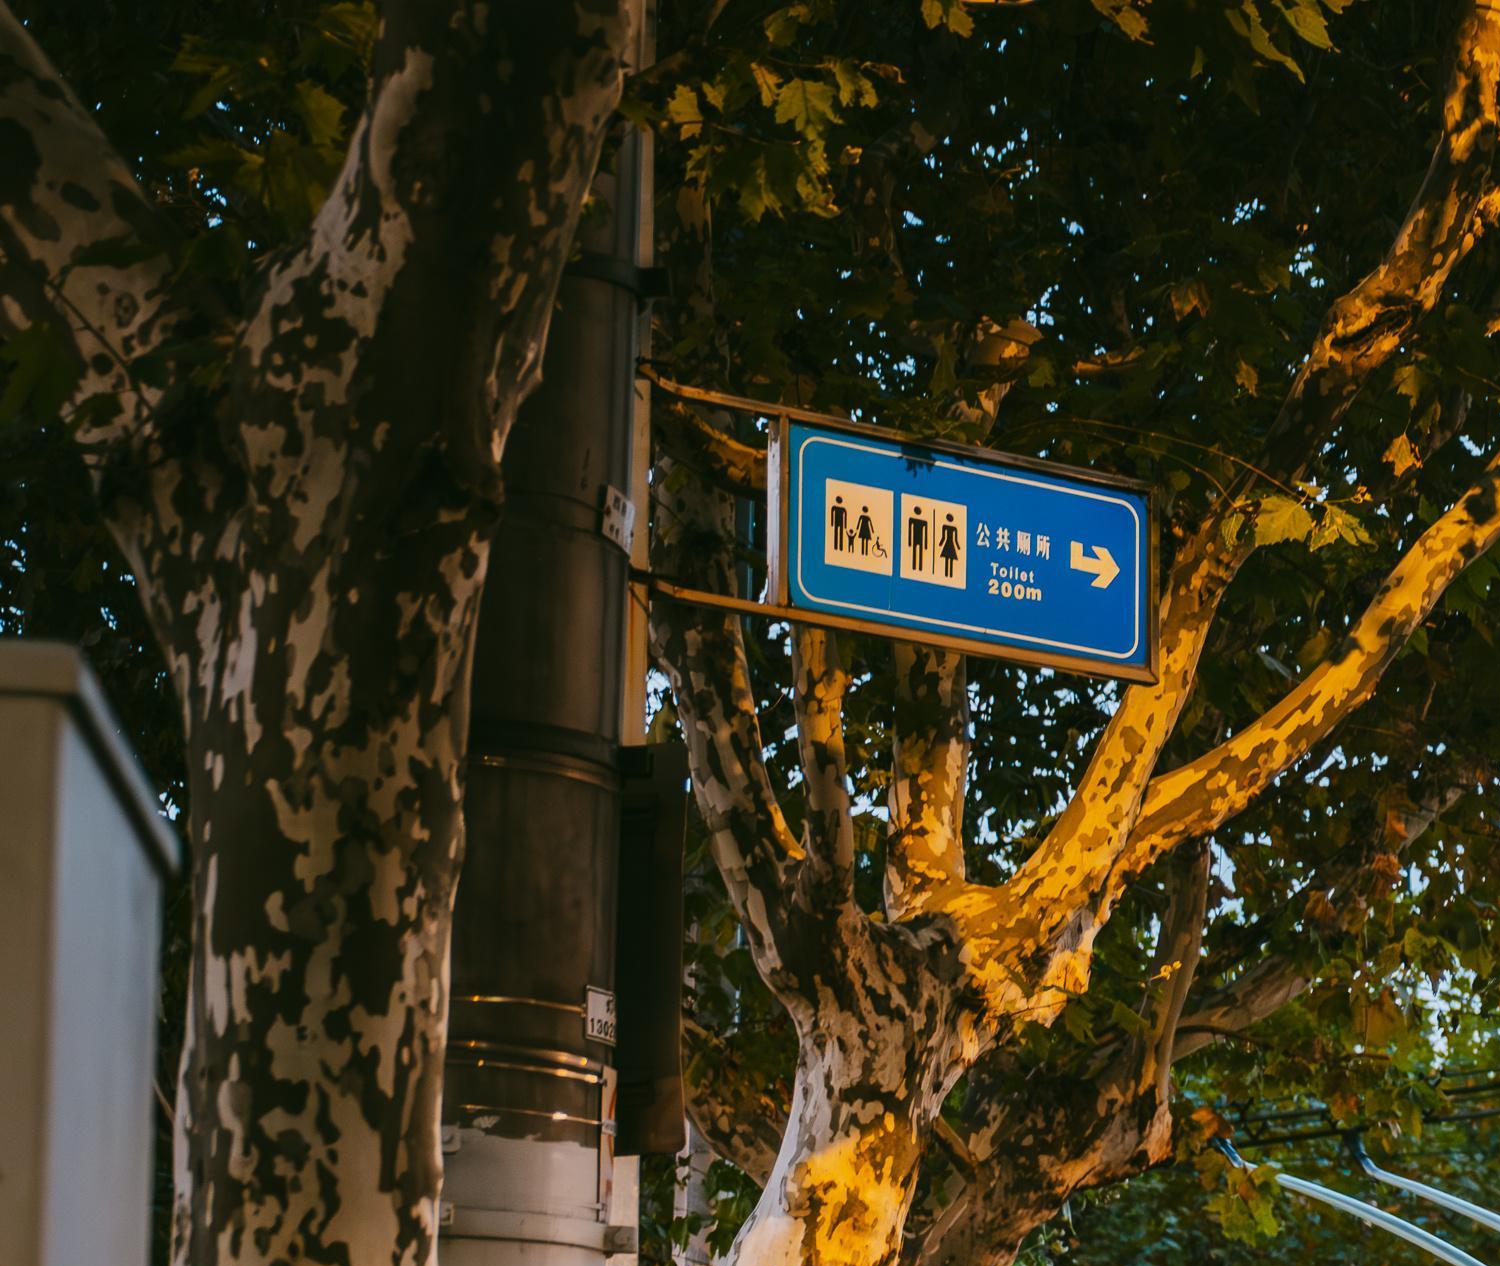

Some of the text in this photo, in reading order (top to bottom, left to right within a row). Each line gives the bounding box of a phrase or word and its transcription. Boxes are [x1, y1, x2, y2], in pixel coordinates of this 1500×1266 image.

[976, 521, 1051, 561] 公共厕所
[990, 561, 1035, 584] Toilet
[987, 578, 1042, 602] 200m
